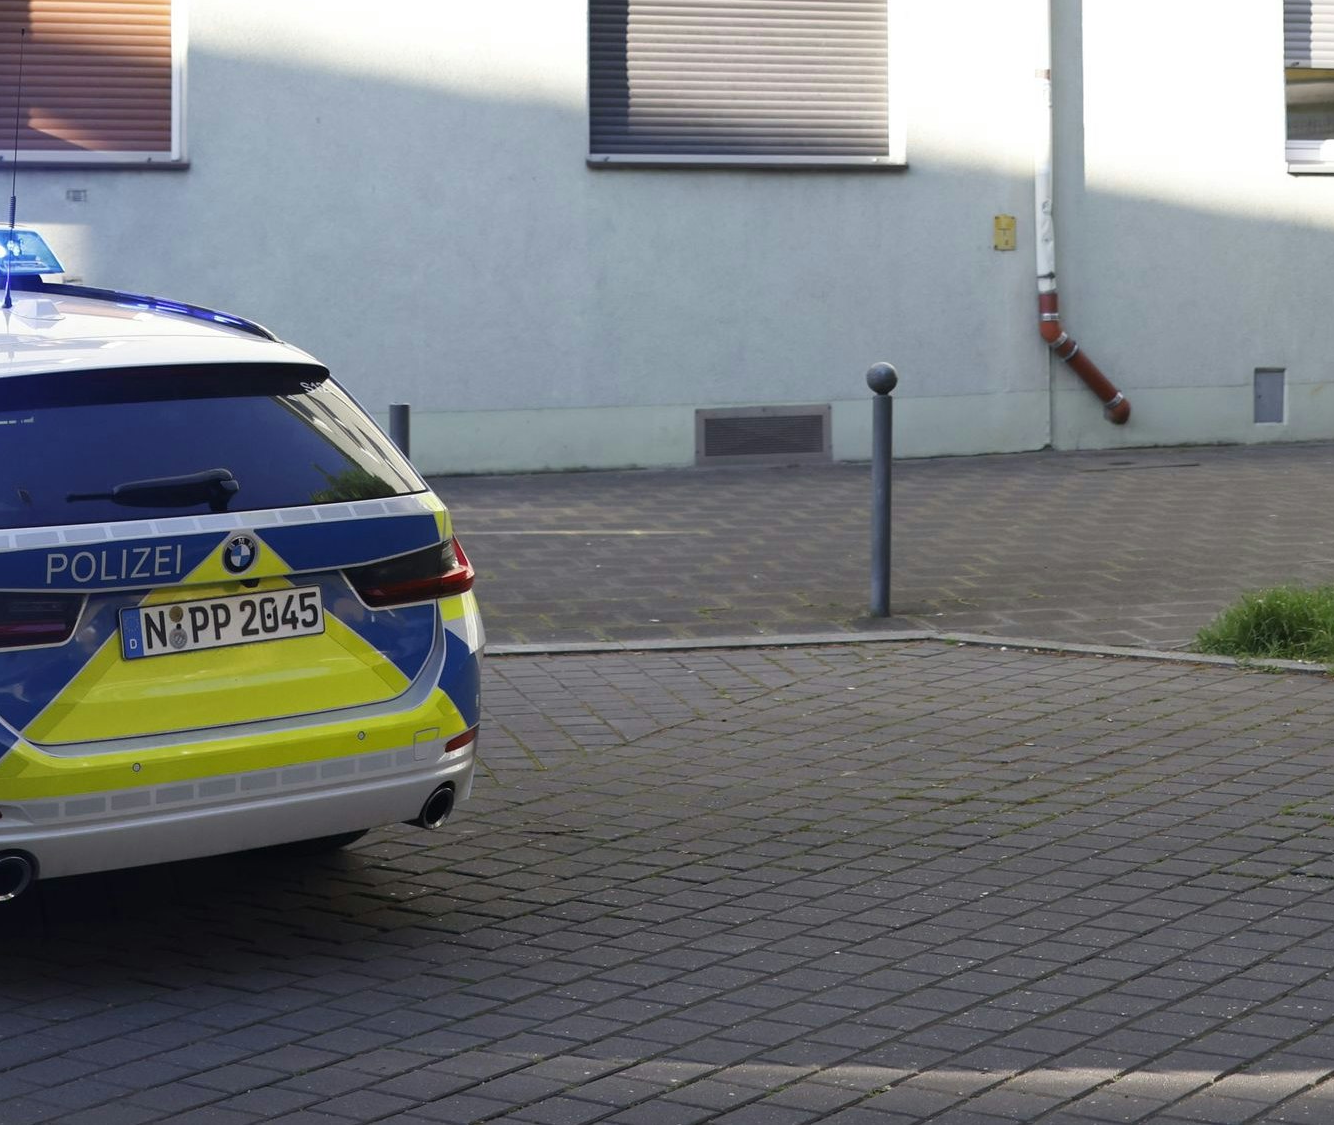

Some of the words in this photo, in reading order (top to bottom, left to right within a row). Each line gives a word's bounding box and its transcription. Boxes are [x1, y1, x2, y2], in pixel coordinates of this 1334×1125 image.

[46, 544, 182, 584] POLIZEI
[144, 611, 167, 649] N
[188, 603, 231, 643] PP
[239, 591, 318, 637] 2045
[129, 638, 137, 650] D
